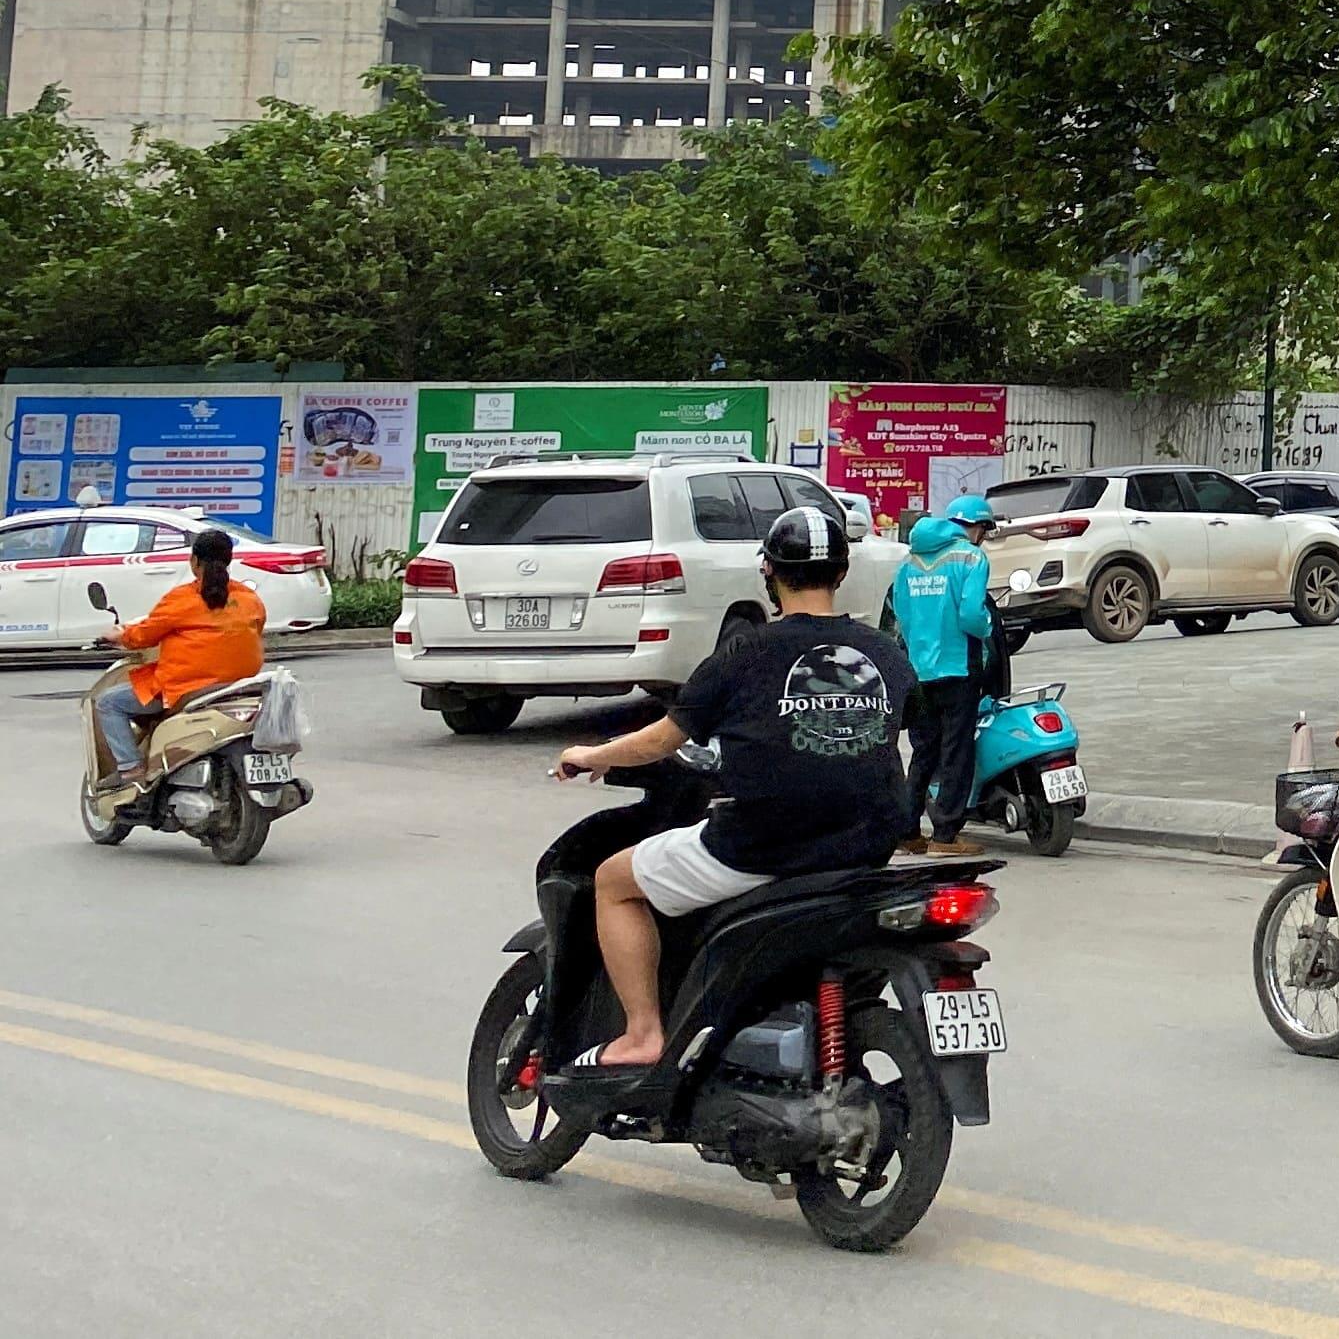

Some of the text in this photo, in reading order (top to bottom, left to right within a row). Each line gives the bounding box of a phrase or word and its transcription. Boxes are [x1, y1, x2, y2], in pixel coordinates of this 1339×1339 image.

[366, 398, 409, 406] COFFEE
[432, 438, 462, 448] Trung
[714, 435, 729, 444] BA
[517, 598, 539, 613] 30A
[778, 696, 893, 717] DON'T PANIC
[936, 993, 990, 1021] 29-L5
[935, 1022, 1001, 1050] 537.30
